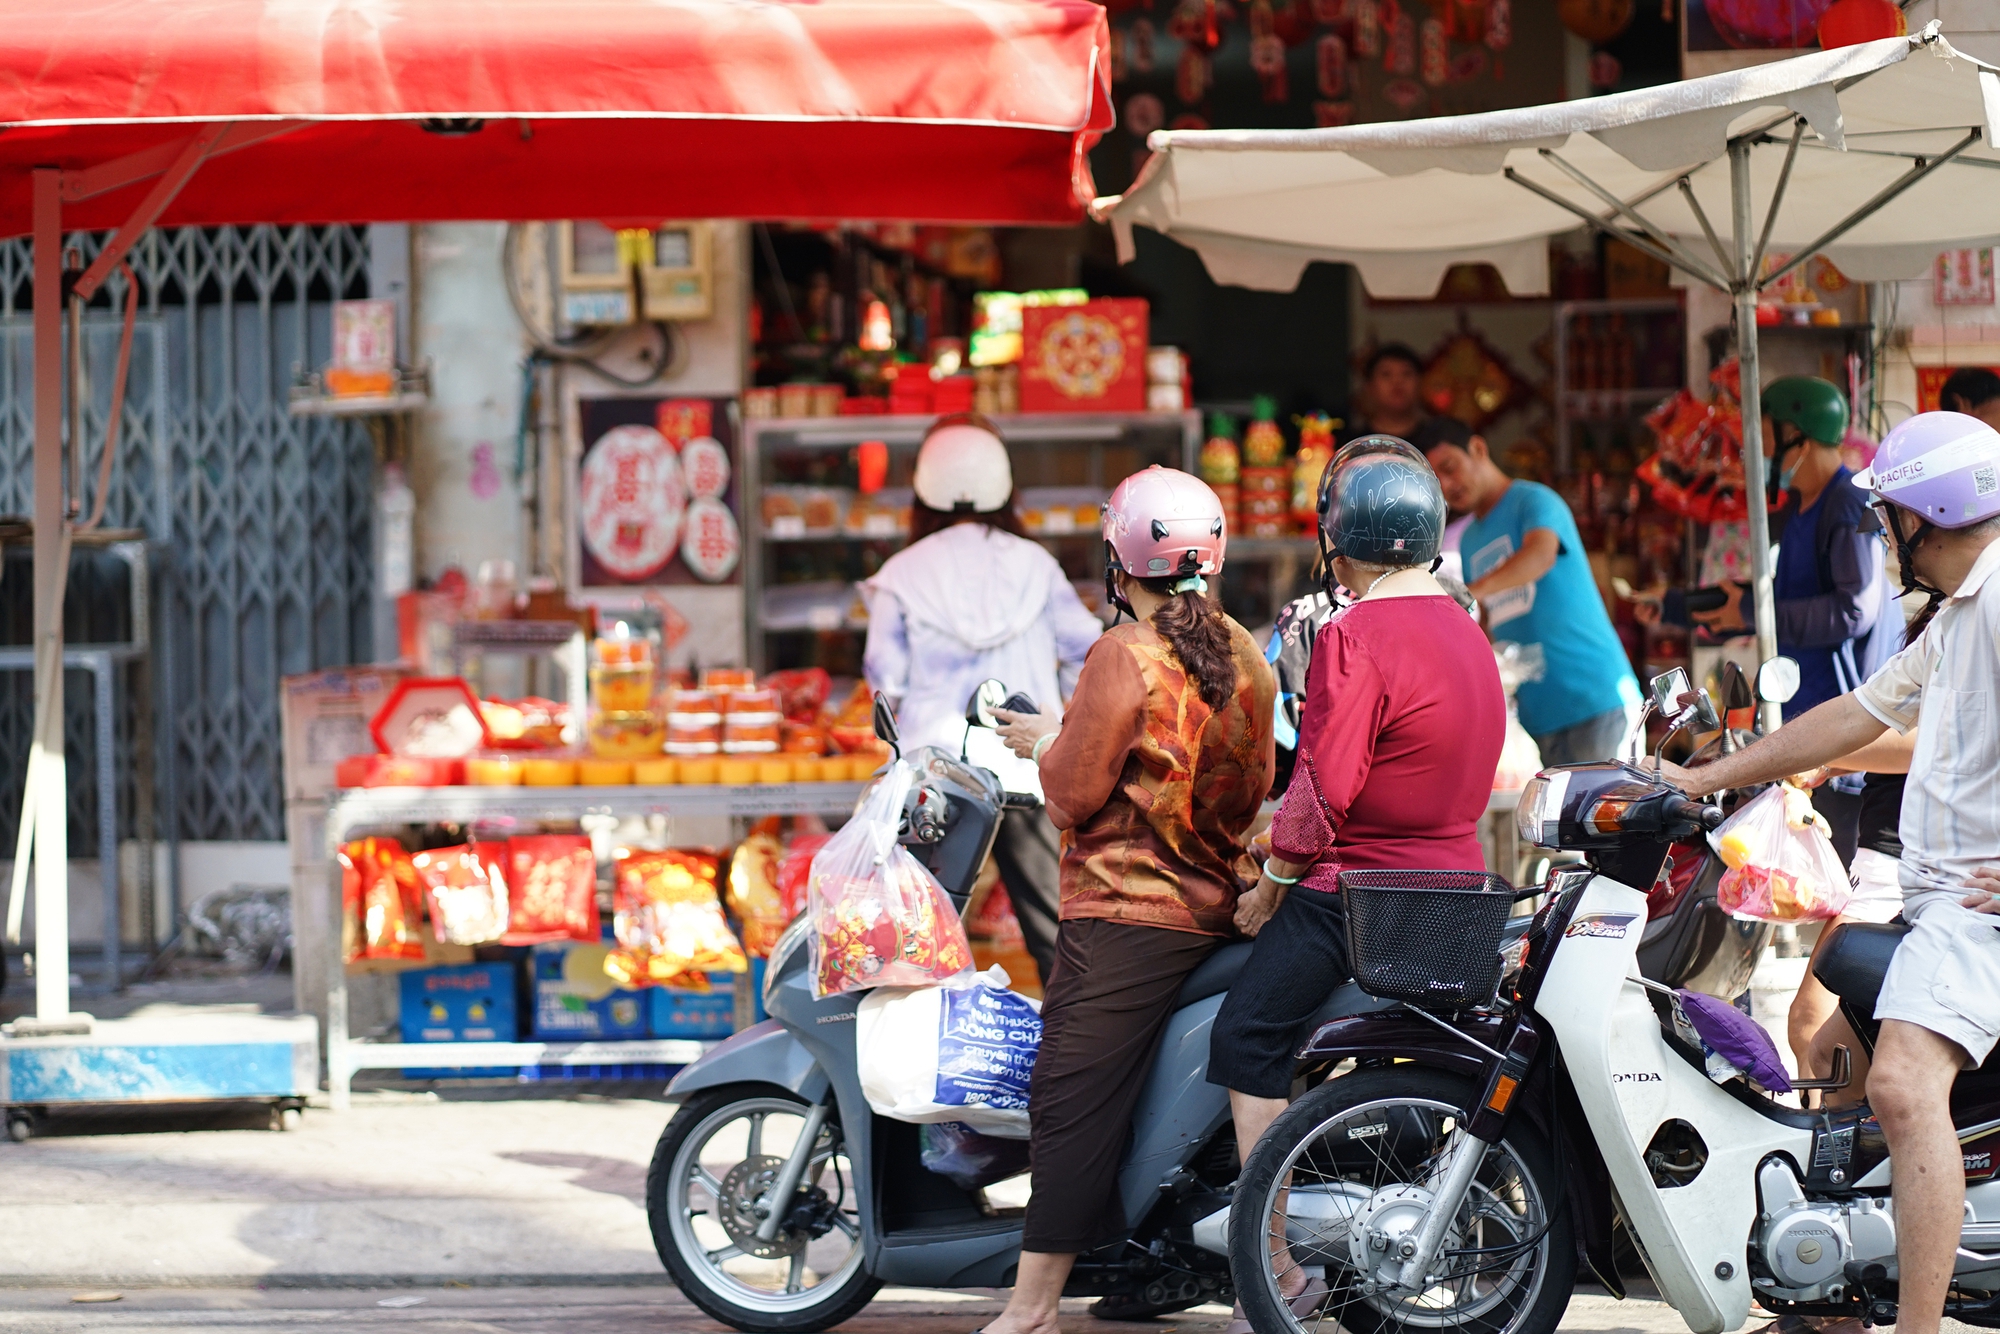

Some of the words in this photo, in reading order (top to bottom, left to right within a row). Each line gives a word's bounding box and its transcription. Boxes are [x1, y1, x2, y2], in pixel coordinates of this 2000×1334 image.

[1881, 461, 1924, 487] PACIFIC
[1906, 472, 1926, 482] TRAVEL
[815, 1012, 857, 1025] HONDA
[958, 1016, 1006, 1041] LONG
[1008, 1030, 1043, 1044] CHÂ
[1015, 1069, 1032, 1083] bá
[1787, 1229, 1832, 1238] HONDA
